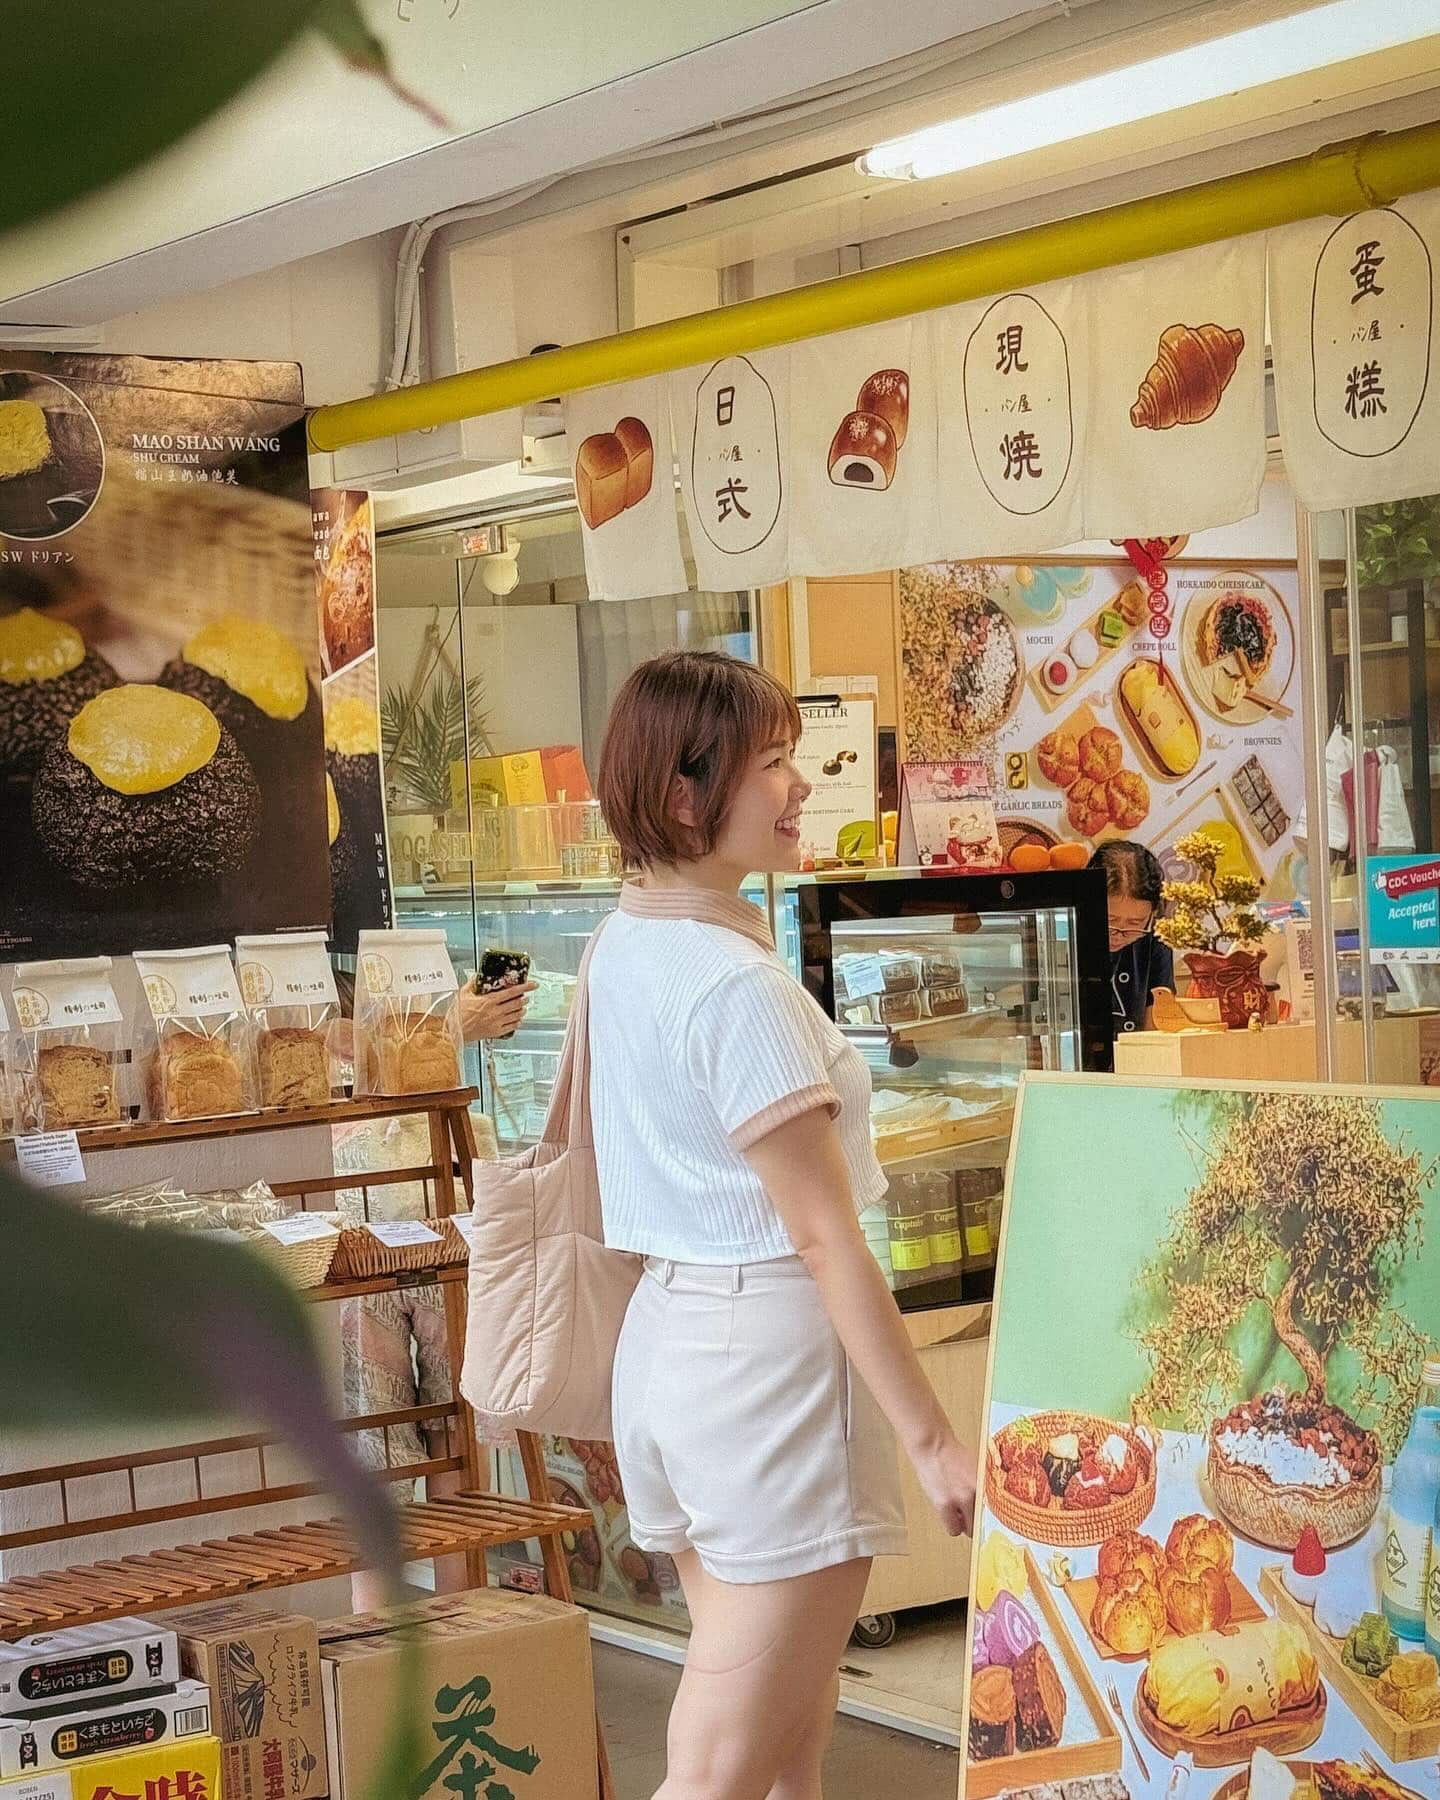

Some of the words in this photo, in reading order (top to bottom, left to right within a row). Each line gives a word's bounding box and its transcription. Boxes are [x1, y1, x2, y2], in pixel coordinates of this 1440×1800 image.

[1350, 240, 1385, 305] 蛋
[995, 325, 1029, 375] 現
[1345, 359, 1387, 420] 糕
[717, 386, 735, 426] 日
[132, 434, 172, 449] MAO
[176, 435, 224, 450] SHAN
[227, 436, 280, 452] WANG
[133, 452, 158, 463] SHU
[160, 453, 199, 464] CREAM
[716, 478, 751, 523] 式
[31, 550, 75, 563] ドリアン
[1176, 580, 1216, 589] HOKKAIDO
[1217, 580, 1265, 590] CHEESECAKE
[1026, 635, 1054, 645] MOCHI
[1132, 642, 1156, 651] CREPE
[1157, 642, 1176, 651] ROLL
[801, 707, 848, 719] SELLER
[1244, 737, 1282, 746] BROWNIES
[1000, 800, 1030, 811] GARLIC
[1031, 800, 1063, 810] BREADS
[1388, 875, 1408, 889] CDC
[1388, 899, 1436, 920] Accepted
[1412, 916, 1437, 931] here
[30, 1670, 107, 1698] くまもといちご
[79, 1709, 156, 1739] くまもといちご
